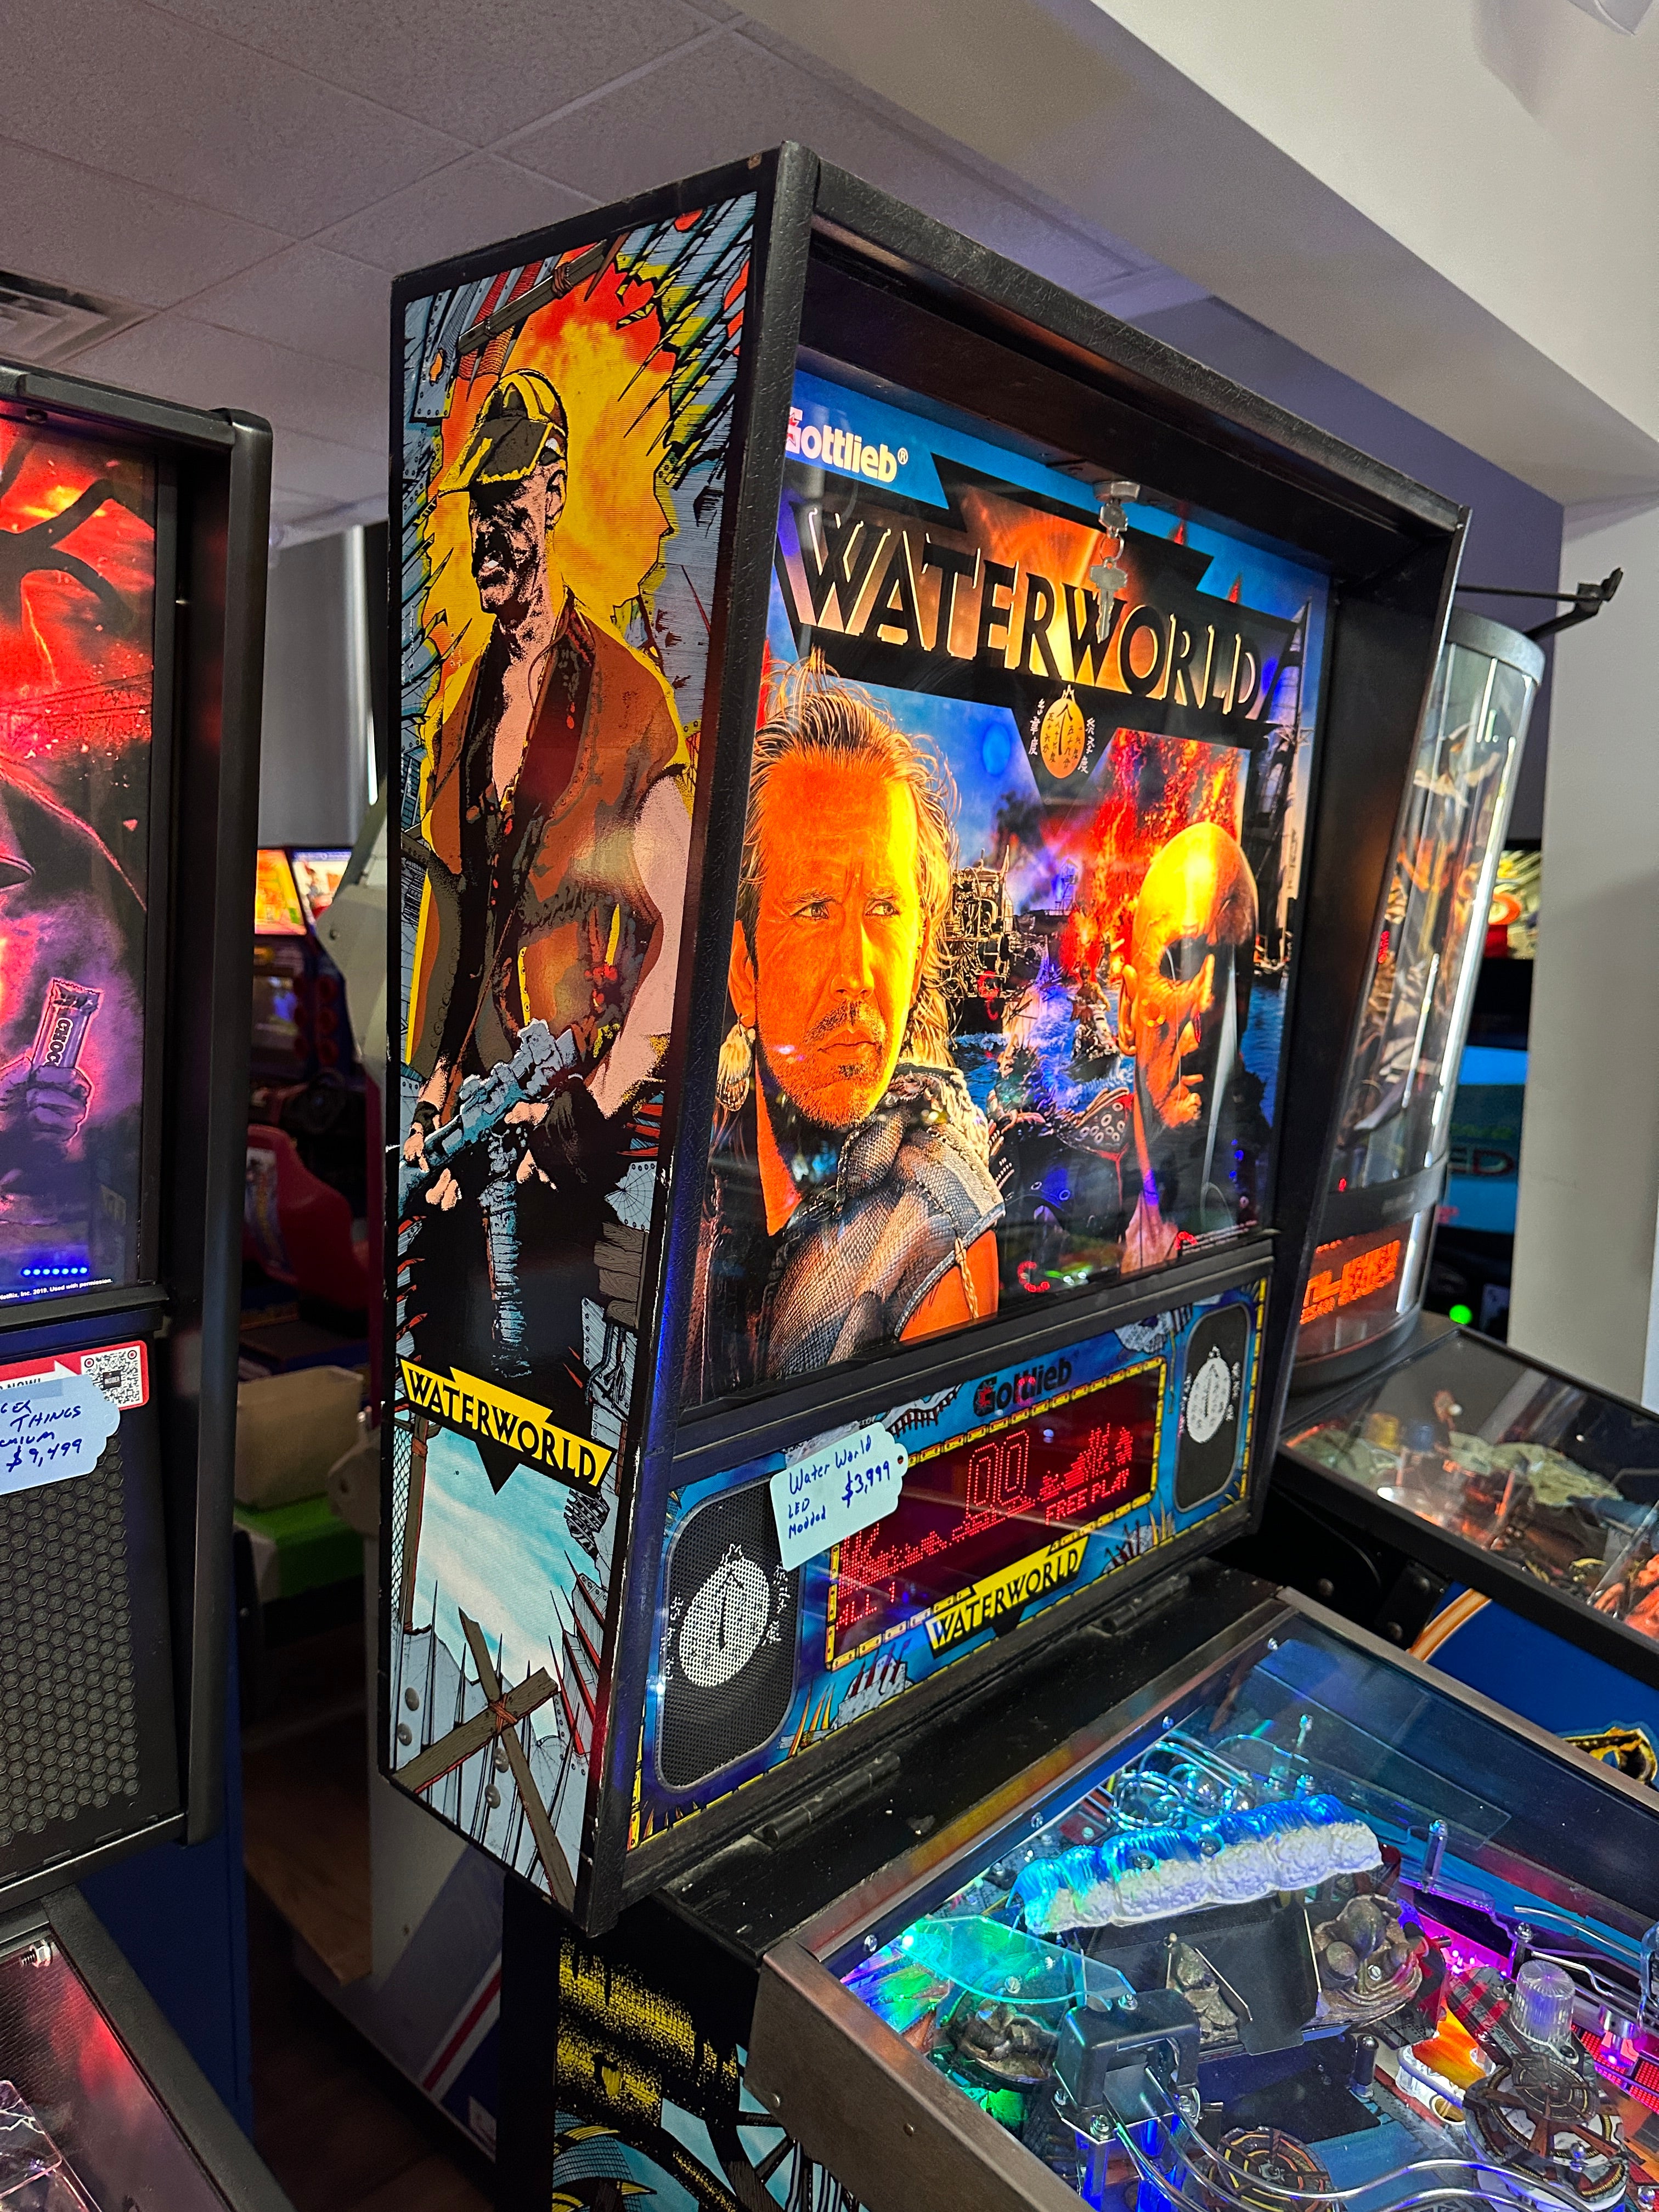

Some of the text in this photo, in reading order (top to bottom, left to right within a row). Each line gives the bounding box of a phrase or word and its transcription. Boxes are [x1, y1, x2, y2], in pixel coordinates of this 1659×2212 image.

[788, 501, 1262, 721] WATERWORLD
[46, 1018, 72, 1065] CHOC
[79, 1278, 113, 1288] permission.
[973, 1357, 1072, 1417] Gottlieb
[10, 1405, 81, 1432] THINGS
[407, 1367, 598, 1486] WATERWORLD
[6, 1438, 82, 1472] $9,499
[789, 1434, 871, 1495] Water World
[788, 1497, 810, 1519] LED
[842, 1460, 890, 1509] $3,999
[1045, 1468, 1130, 1526] FREE PLAY
[788, 1504, 826, 1539] Modded
[927, 1547, 1081, 1649] WATERWORLD
